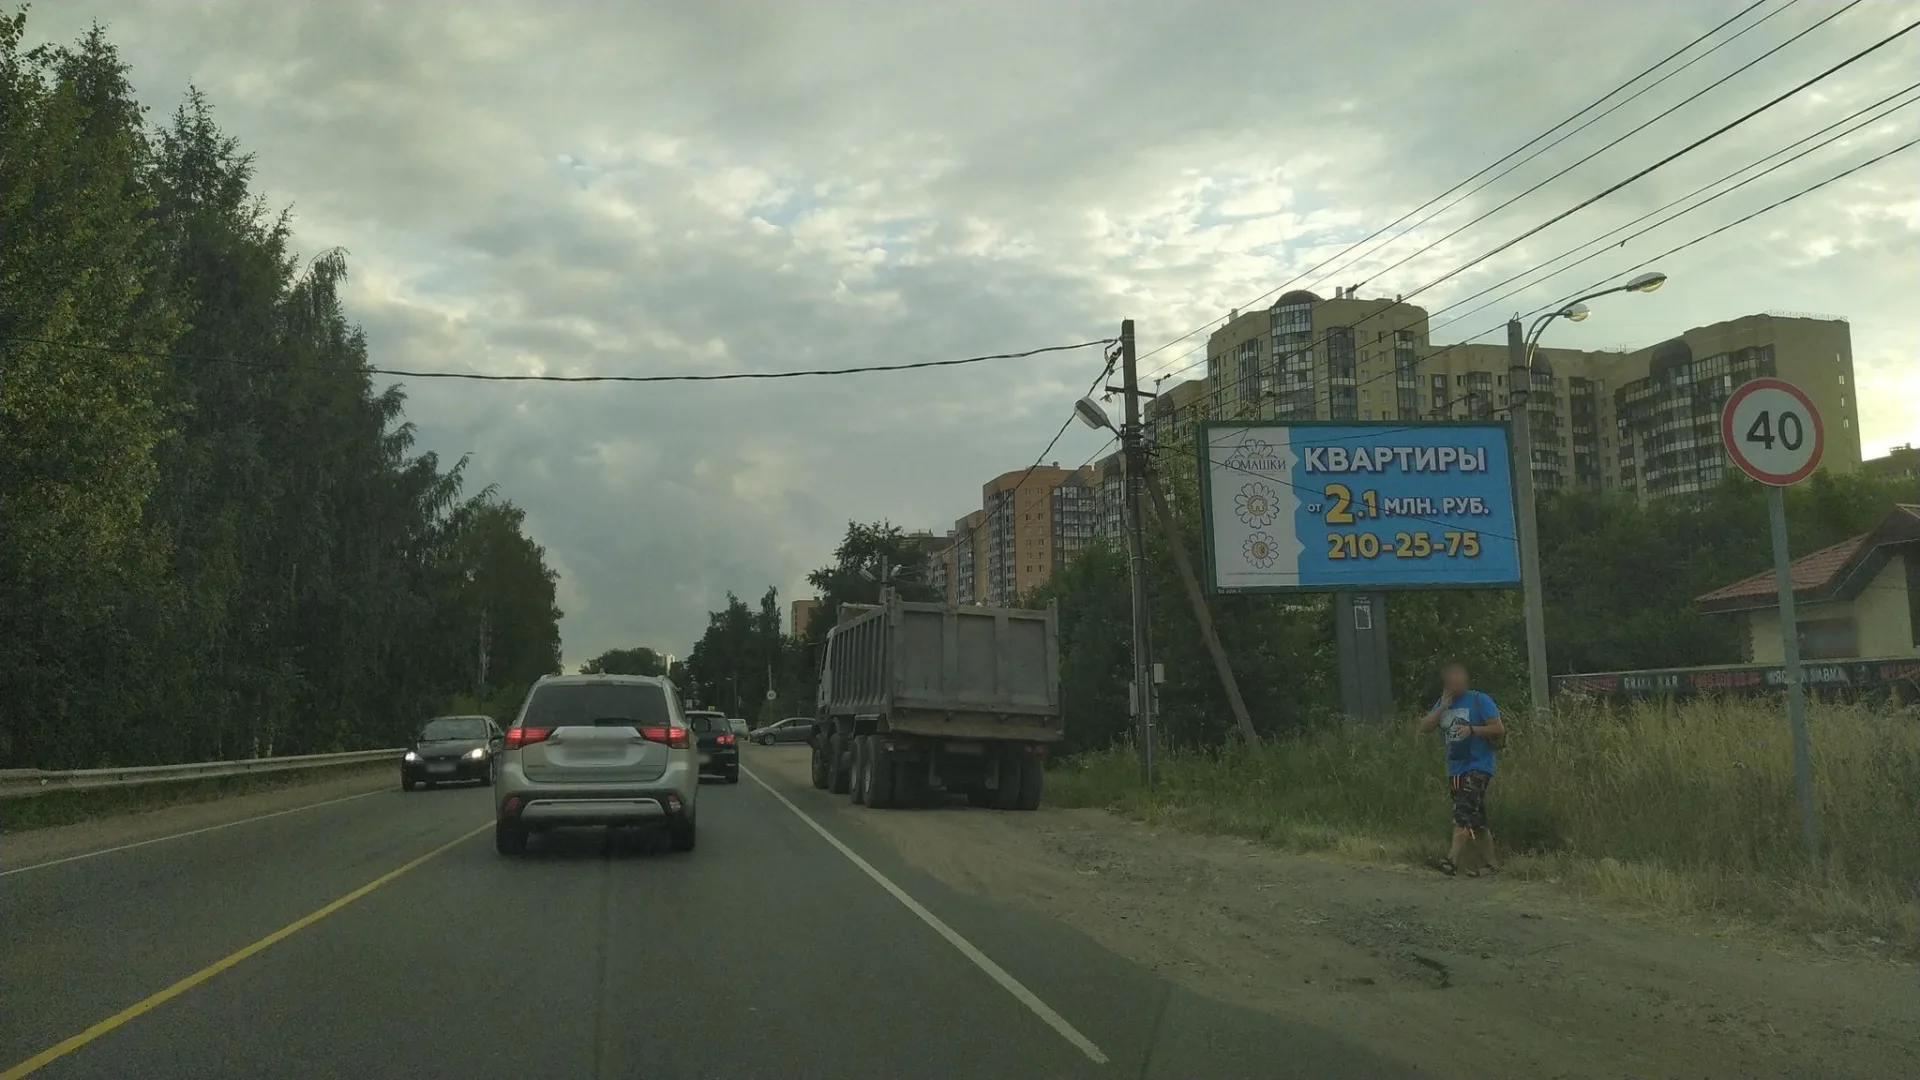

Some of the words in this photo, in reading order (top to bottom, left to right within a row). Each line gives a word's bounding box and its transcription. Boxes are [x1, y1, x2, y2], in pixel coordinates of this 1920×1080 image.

[1746, 410, 1803, 451] 40
[1225, 459, 1287, 471] РОМАШКИ
[1304, 446, 1487, 473] КВАРТИРЫ
[1324, 483, 1377, 524] 2.1
[1384, 498, 1437, 515] МЛН.
[1443, 498, 1490, 514] РУБ.
[1327, 532, 1480, 559] 210-25-75
